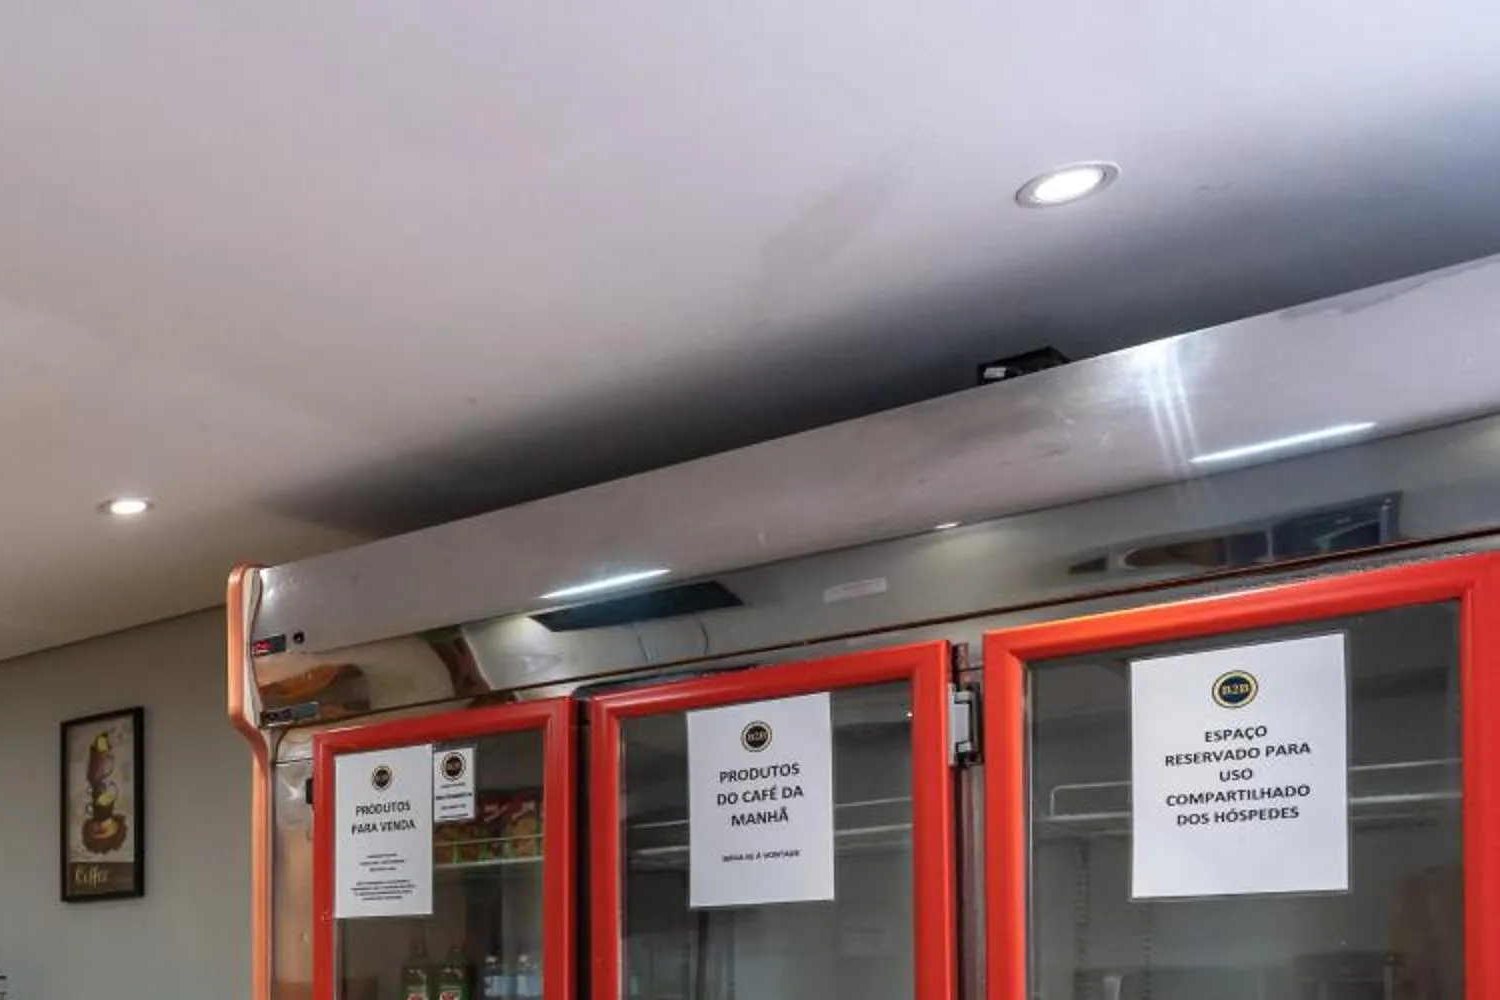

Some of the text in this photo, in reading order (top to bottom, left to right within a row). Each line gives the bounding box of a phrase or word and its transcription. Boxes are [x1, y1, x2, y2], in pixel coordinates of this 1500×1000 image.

[1205, 725, 1268, 742] ESPAÇO
[1165, 742, 1311, 766] RESERVADO PARA
[719, 763, 800, 783] PRODUTOS
[1219, 768, 1253, 782] USO
[717, 785, 804, 806] DO CAFÉ DA
[1166, 785, 1311, 807] COMPARTILHADO
[356, 800, 411, 816] PRODUTOS
[732, 807, 789, 827] MANHÃ
[1177, 806, 1299, 826] DOS HÓSPEDES
[352, 819, 417, 835] PARA VENDA
